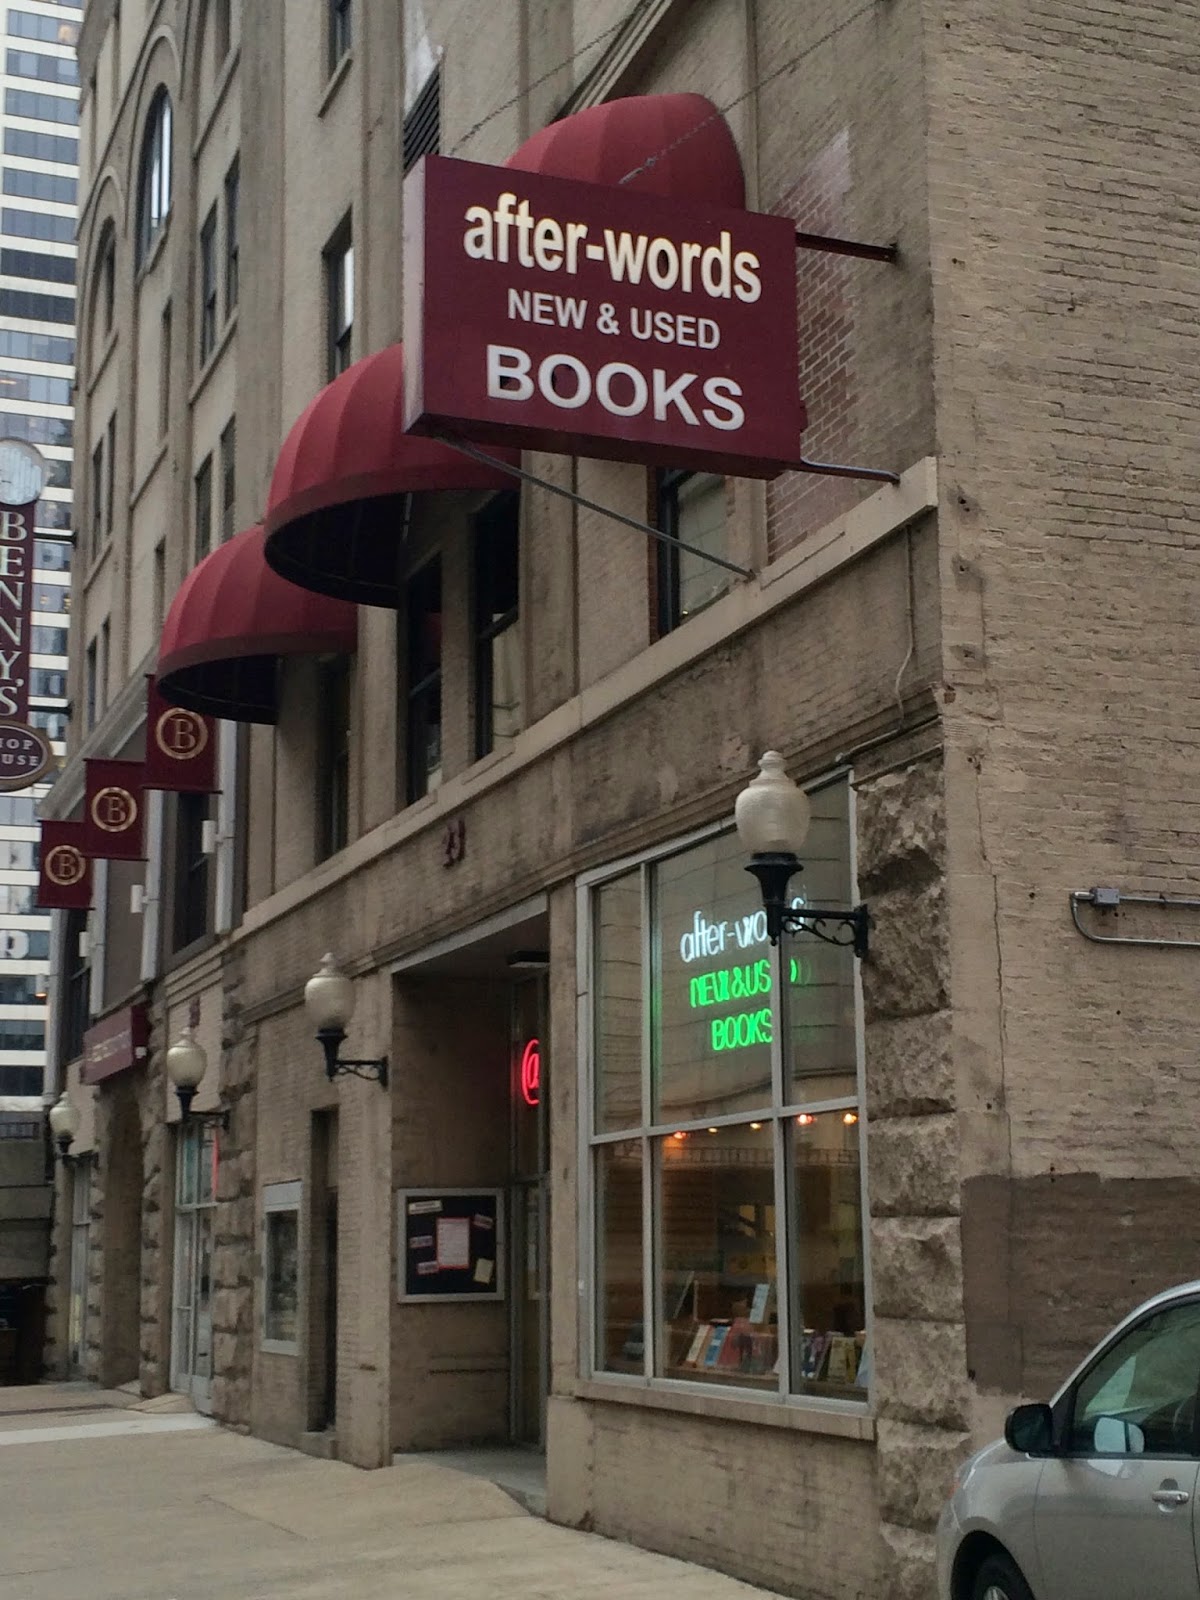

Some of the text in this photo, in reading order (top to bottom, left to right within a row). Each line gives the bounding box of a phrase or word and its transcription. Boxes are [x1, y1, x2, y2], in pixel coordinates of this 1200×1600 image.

[462, 192, 762, 303] after-words
[508, 288, 720, 350] NEW & USED
[486, 344, 745, 431] BOOKS
[169, 718, 196, 749] B
[103, 796, 126, 823] B
[57, 853, 76, 878] B
[746, 959, 798, 994] US
[711, 1008, 773, 1051] BOOKS
